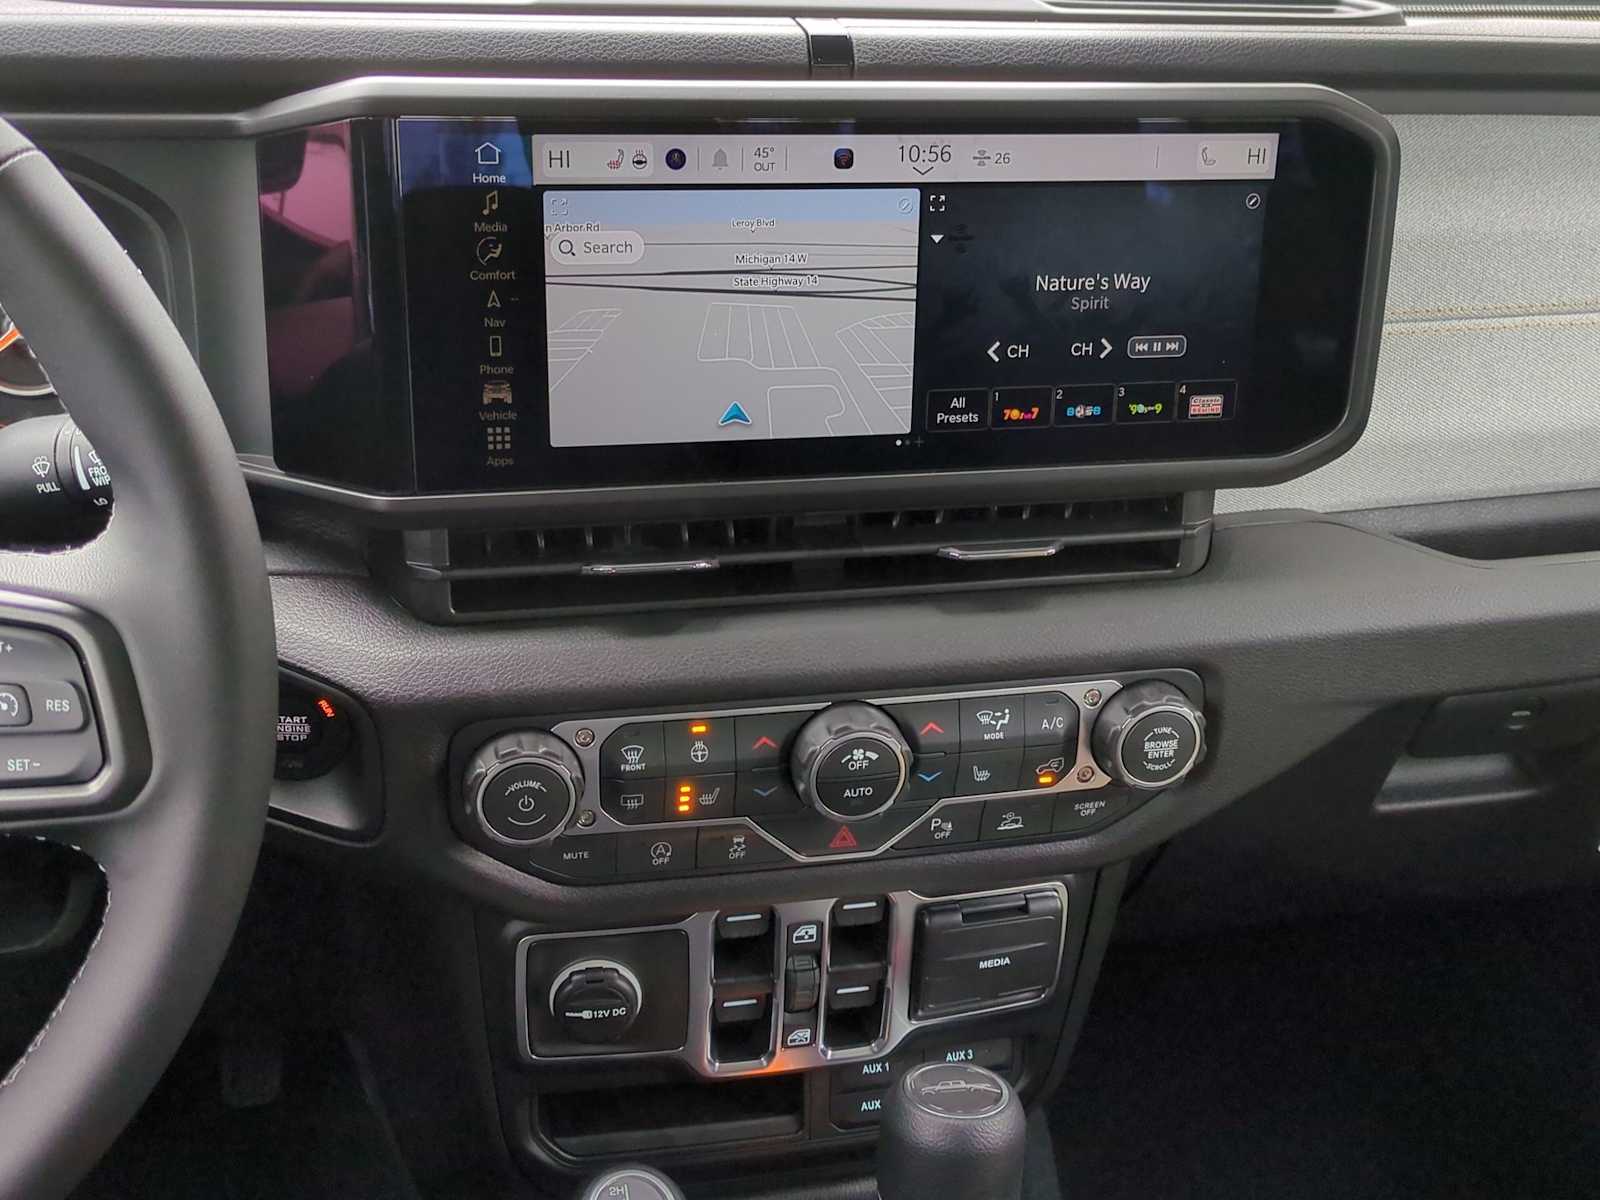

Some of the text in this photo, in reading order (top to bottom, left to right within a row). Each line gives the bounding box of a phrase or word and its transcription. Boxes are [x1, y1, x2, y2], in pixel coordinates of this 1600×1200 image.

[753, 147, 775, 159] 45°
[898, 144, 952, 164] 10:56
[994, 151, 1011, 165] 26
[1246, 147, 1266, 166] HI
[548, 150, 570, 169] HI
[753, 162, 776, 172] OUT
[472, 173, 506, 184] Home
[474, 222, 507, 233] Media
[554, 223, 584, 232] Arbor
[586, 223, 600, 232] Rd
[731, 219, 775, 229] Leroy Blvd
[583, 241, 633, 254] Search
[735, 254, 808, 265] Michigan 14 W
[469, 270, 516, 281] Comfort
[734, 276, 818, 288] State Highway 14
[1035, 273, 1151, 293] Nature's Way
[1071, 296, 1110, 312] Spirit
[484, 318, 506, 328] Nav
[1007, 345, 1030, 358] CH
[1071, 343, 1093, 356] CH
[479, 364, 514, 375] Phone
[1056, 389, 1063, 399] 2
[1118, 387, 1125, 397] 3
[1179, 384, 1186, 394] 4
[994, 392, 999, 401] 1
[950, 397, 966, 409] All
[479, 410, 517, 421] Vehicle
[936, 411, 979, 424] Presets
[486, 456, 514, 467] Apps
[88, 465, 107, 478] FRO
[92, 475, 111, 487] WIP
[36, 481, 60, 493] PULL
[46, 699, 70, 712] RES
[318, 699, 335, 718] RUN
[279, 715, 308, 723] TART
[1041, 717, 1064, 730] A/C
[277, 725, 311, 733] NGINE
[1153, 726, 1173, 734] TUNE
[983, 732, 1005, 740] MODE
[1144, 739, 1179, 749] BROWSE
[1148, 750, 1175, 759] ENTER
[620, 763, 646, 772] FRONT
[848, 760, 869, 771] OFF
[1146, 762, 1172, 771] SCROLL
[508, 780, 541, 791] VOLUME
[843, 787, 873, 799] AUTO
[1074, 800, 1106, 811] SCREEN
[1080, 808, 1096, 817] OFF
[934, 831, 951, 839] OFF
[563, 851, 589, 860] MUTE
[728, 851, 746, 860] OFF
[652, 857, 670, 866] OFF
[979, 957, 1011, 969] MEDIA
[593, 1007, 626, 1018] 12V DC
[946, 1049, 974, 1062] AUX 3
[862, 1062, 890, 1075] AUX 1
[861, 1100, 881, 1112] AUX
[609, 1185, 624, 1196] 2H
